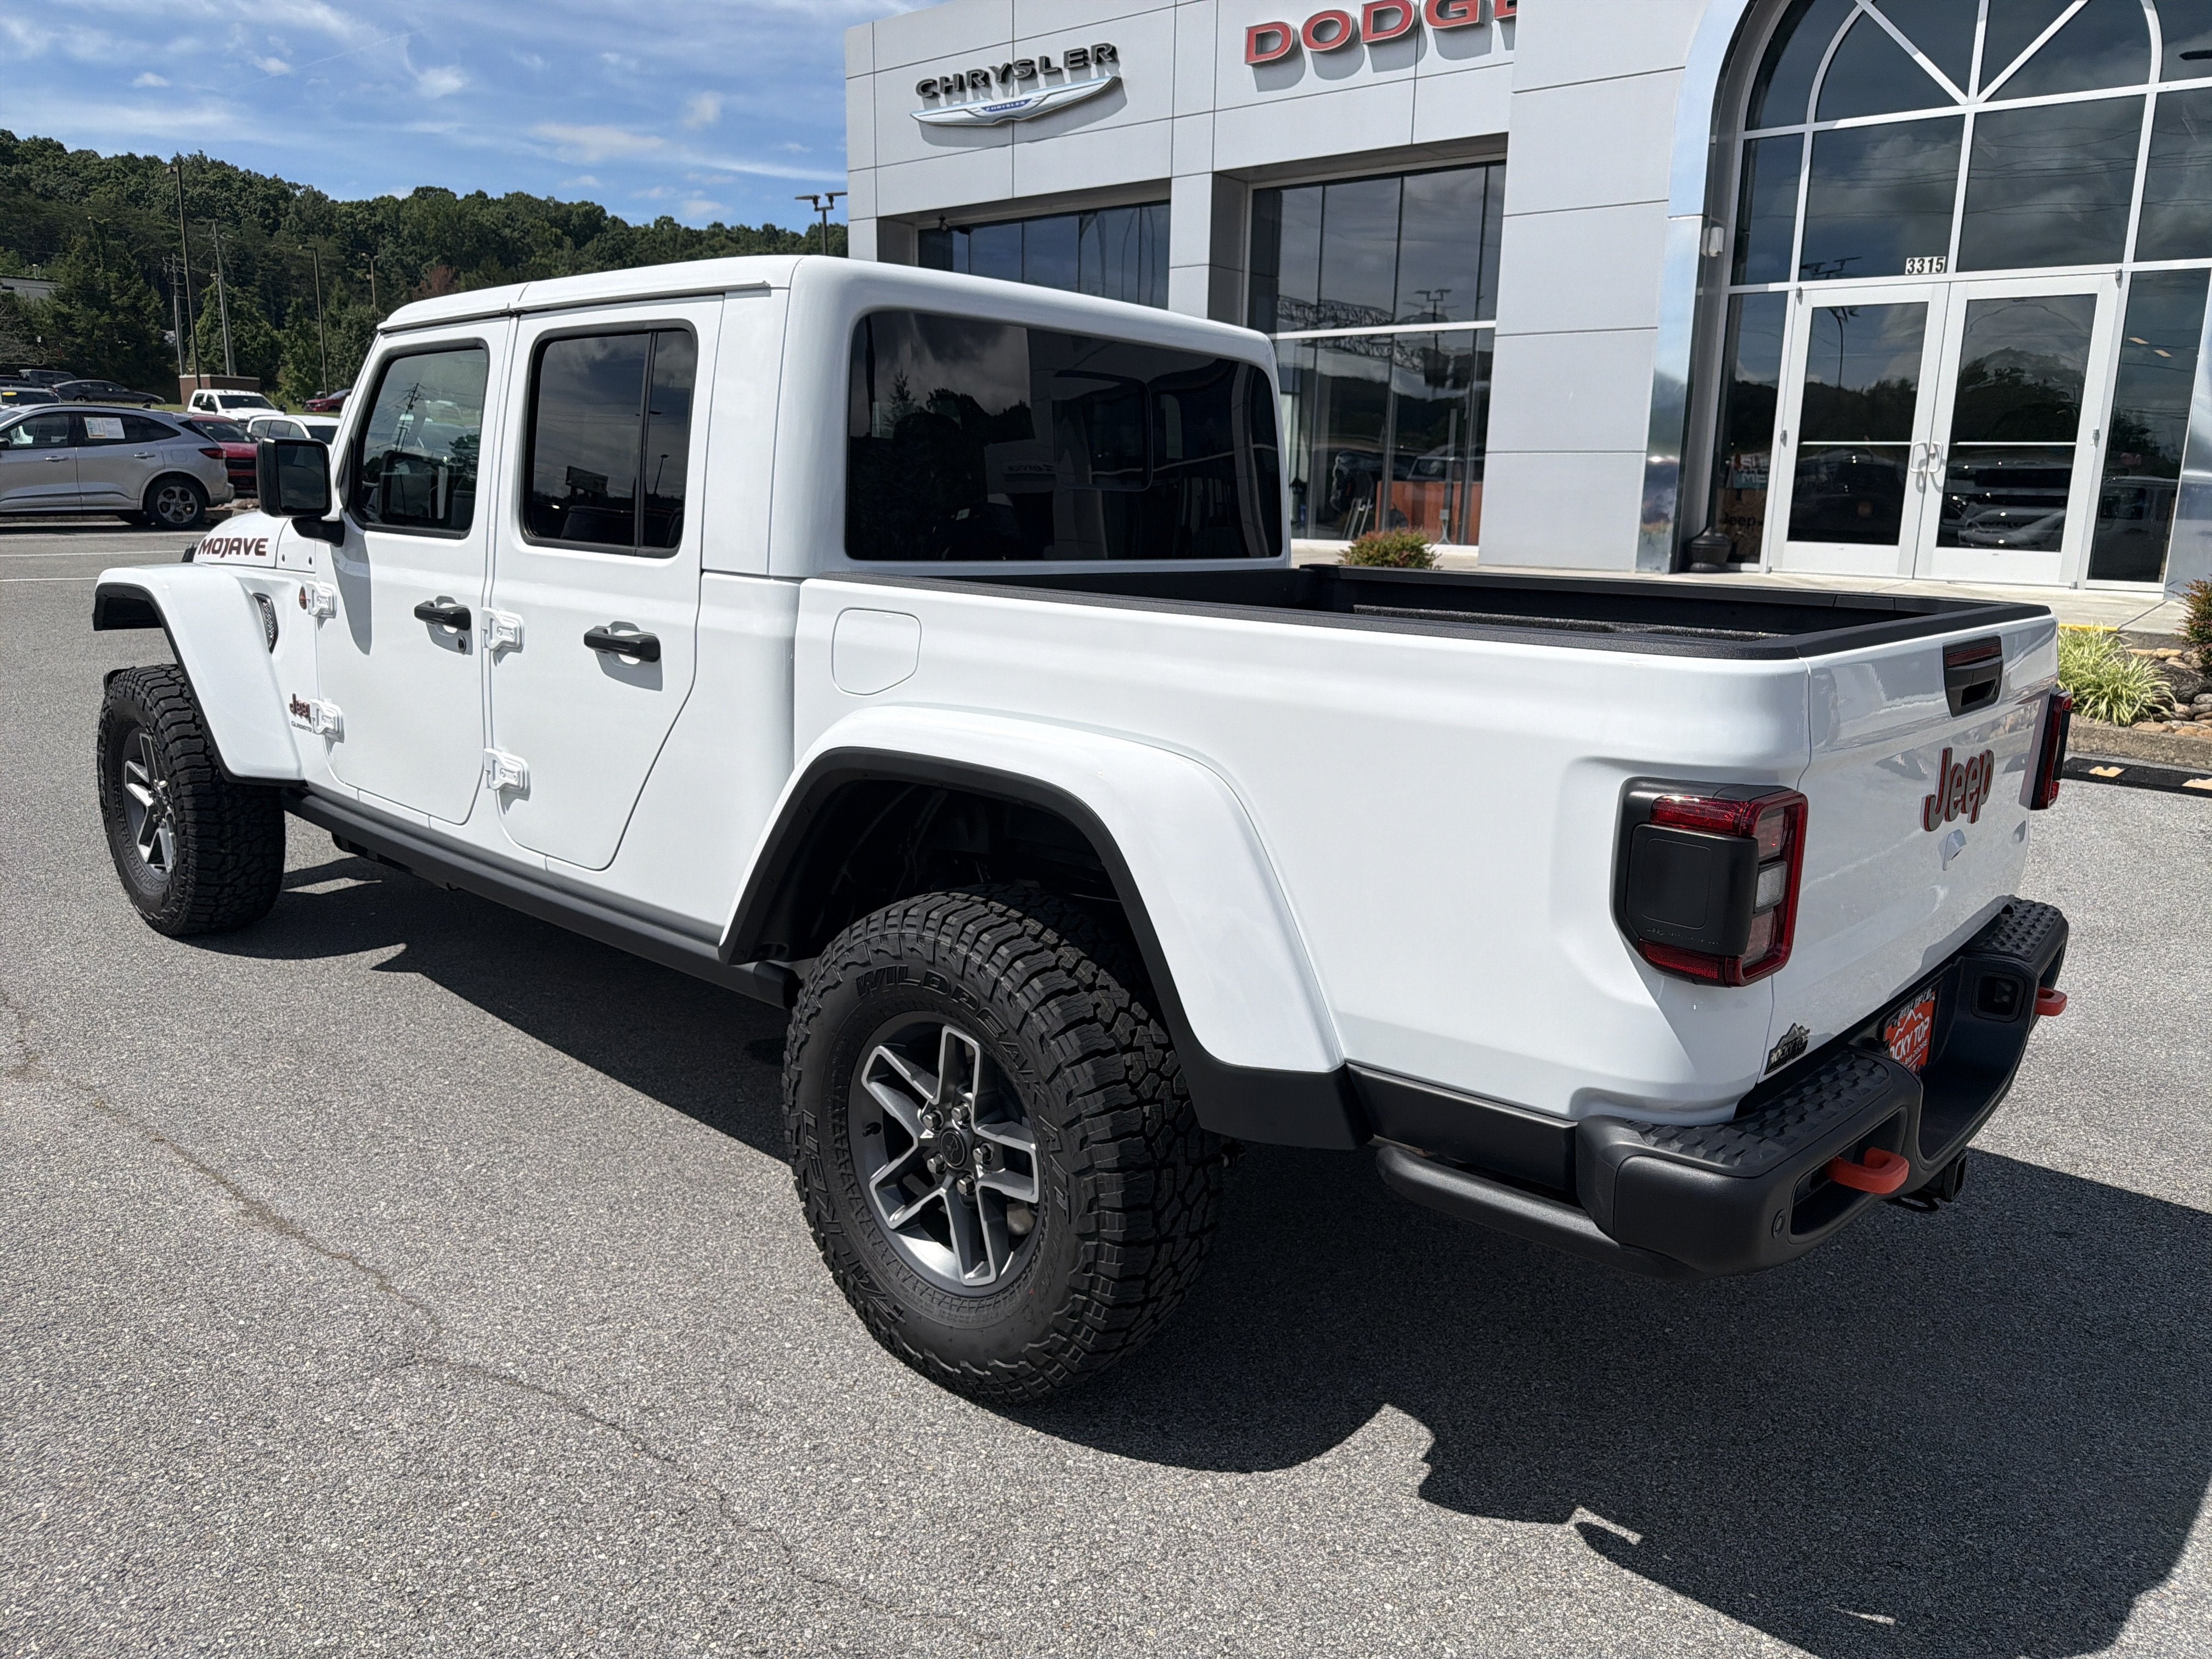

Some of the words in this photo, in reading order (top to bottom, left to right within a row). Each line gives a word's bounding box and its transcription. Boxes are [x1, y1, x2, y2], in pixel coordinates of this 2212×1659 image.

[1245, 0, 1516, 64] DODG
[916, 43, 1119, 98] CHRYSLER
[1907, 257, 1944, 274] 3315
[198, 537, 269, 558] MOJAVE
[291, 720, 312, 733] GLADIATO
[1922, 747, 1995, 832] Jeep
[1890, 1030, 1914, 1060] OCKY
[1914, 1015, 1930, 1046] TOP
